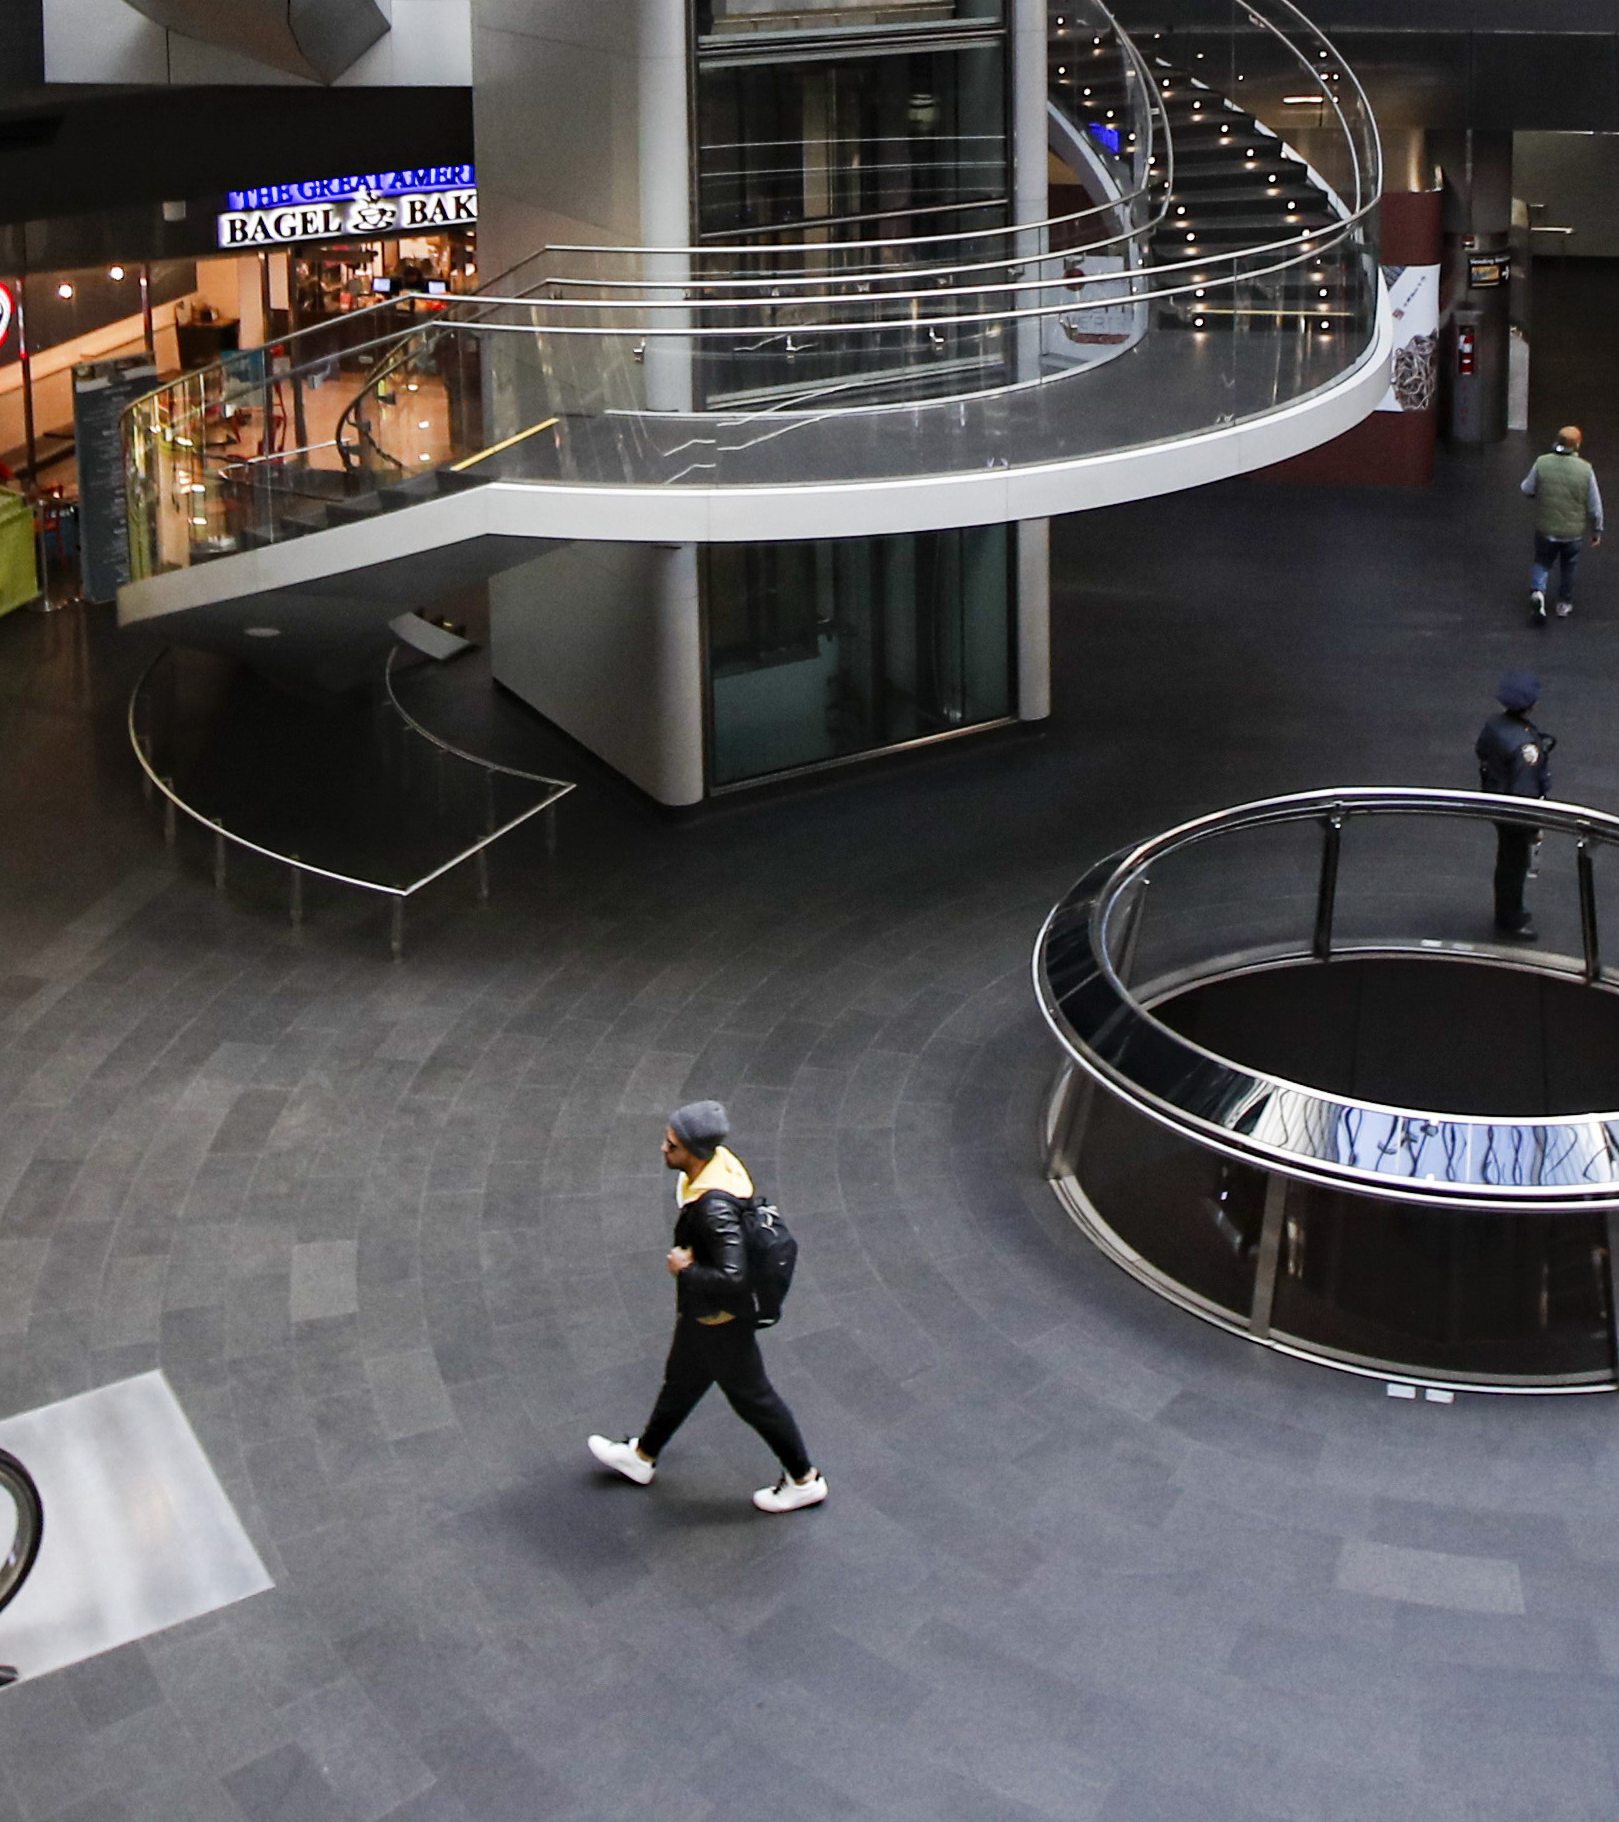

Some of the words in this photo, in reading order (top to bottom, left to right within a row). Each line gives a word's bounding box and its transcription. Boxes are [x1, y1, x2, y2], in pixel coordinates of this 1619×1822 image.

[227, 186, 293, 213] THE
[297, 175, 383, 203] GREAT
[227, 208, 344, 245] BAGEL
[408, 192, 476, 226] BAK
